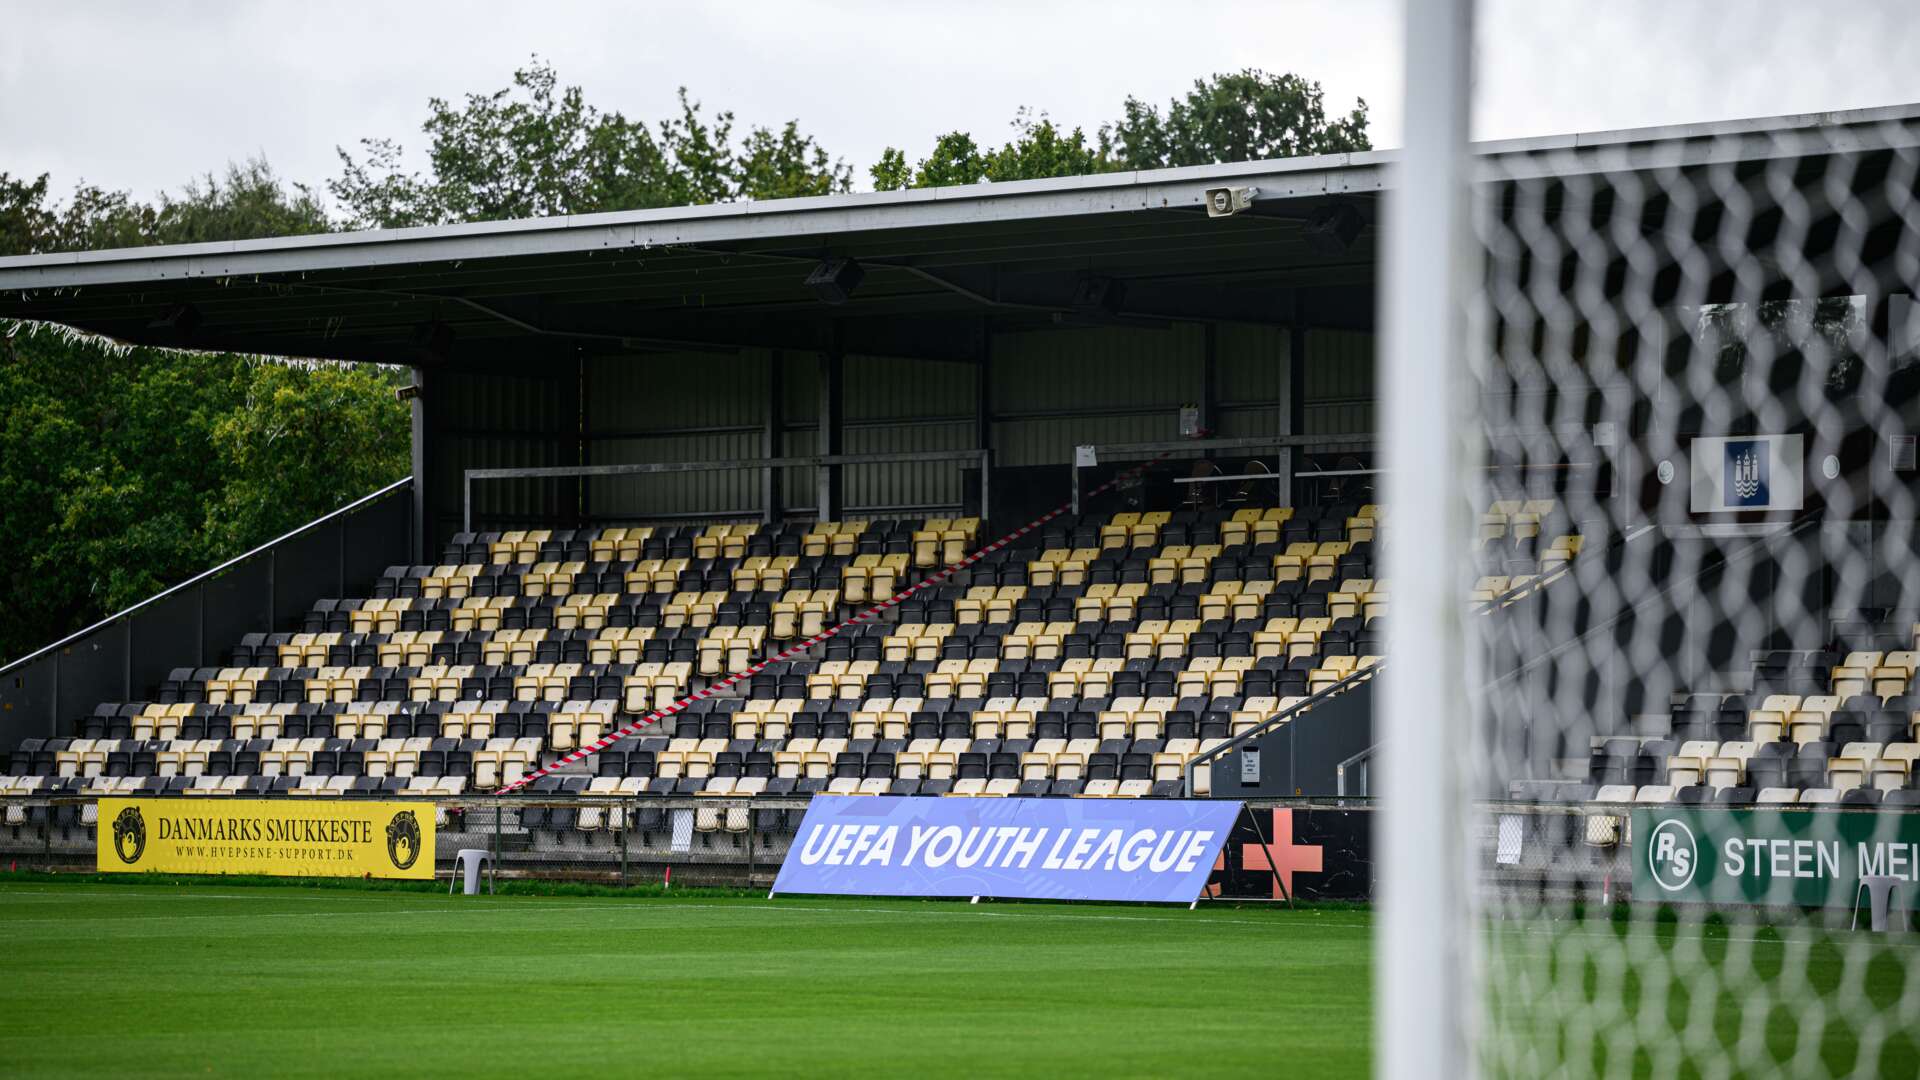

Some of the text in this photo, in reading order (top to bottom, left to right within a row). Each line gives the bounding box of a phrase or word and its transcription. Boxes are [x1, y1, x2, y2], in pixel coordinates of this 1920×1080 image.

[158, 817, 262, 841] DANMARKS
[266, 818, 373, 843] SMUKKESTE
[175, 845, 353, 861] WWW.HVEPSENE-SUPPORT.DK
[801, 824, 898, 867] UEFA
[901, 825, 1042, 869] YOUTH
[1042, 828, 1215, 872] LEAGUE
[1724, 838, 1840, 879] STEEN
